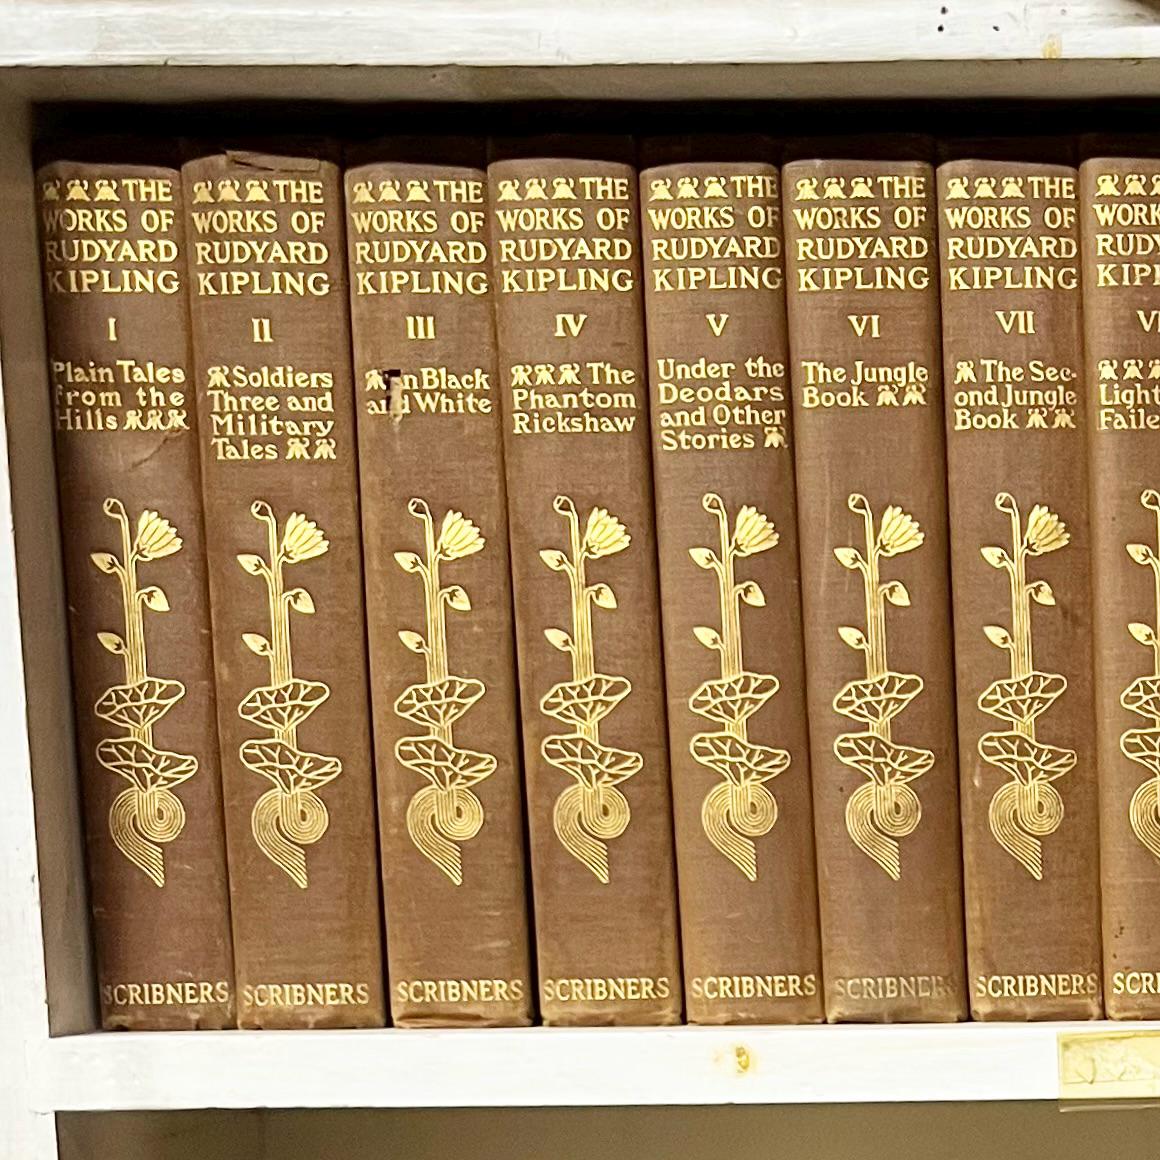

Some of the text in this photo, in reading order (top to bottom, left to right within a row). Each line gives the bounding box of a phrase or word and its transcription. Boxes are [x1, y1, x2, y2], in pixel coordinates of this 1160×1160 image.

[579, 177, 628, 199] THE
[1028, 176, 1075, 199] THE
[495, 208, 629, 232] WORKS OF
[499, 238, 631, 262] RUDYARD
[502, 268, 633, 293] KIPLING
[554, 314, 587, 336] IV
[995, 311, 1035, 333] VII
[54, 360, 185, 383] Plain Tales
[233, 365, 333, 388] Soldiers
[420, 367, 490, 389] Black
[586, 362, 635, 384] The
[657, 356, 784, 380] Under the
[801, 361, 928, 389] The Jungle
[980, 359, 1024, 382] The
[136, 386, 184, 406] the
[207, 390, 334, 412] Three and
[413, 392, 491, 413] White
[512, 388, 636, 410] Phantom
[658, 381, 784, 404] Deodars
[802, 386, 869, 408] Book
[954, 384, 1076, 411] ond Jungle
[210, 414, 334, 437] Military
[512, 412, 635, 434] Rickshaw
[660, 404, 785, 427] and Other
[954, 408, 1019, 430] Book
[213, 438, 277, 460] Tales
[659, 430, 754, 450] Stories
[394, 980, 523, 1005] SCRIBNERS
